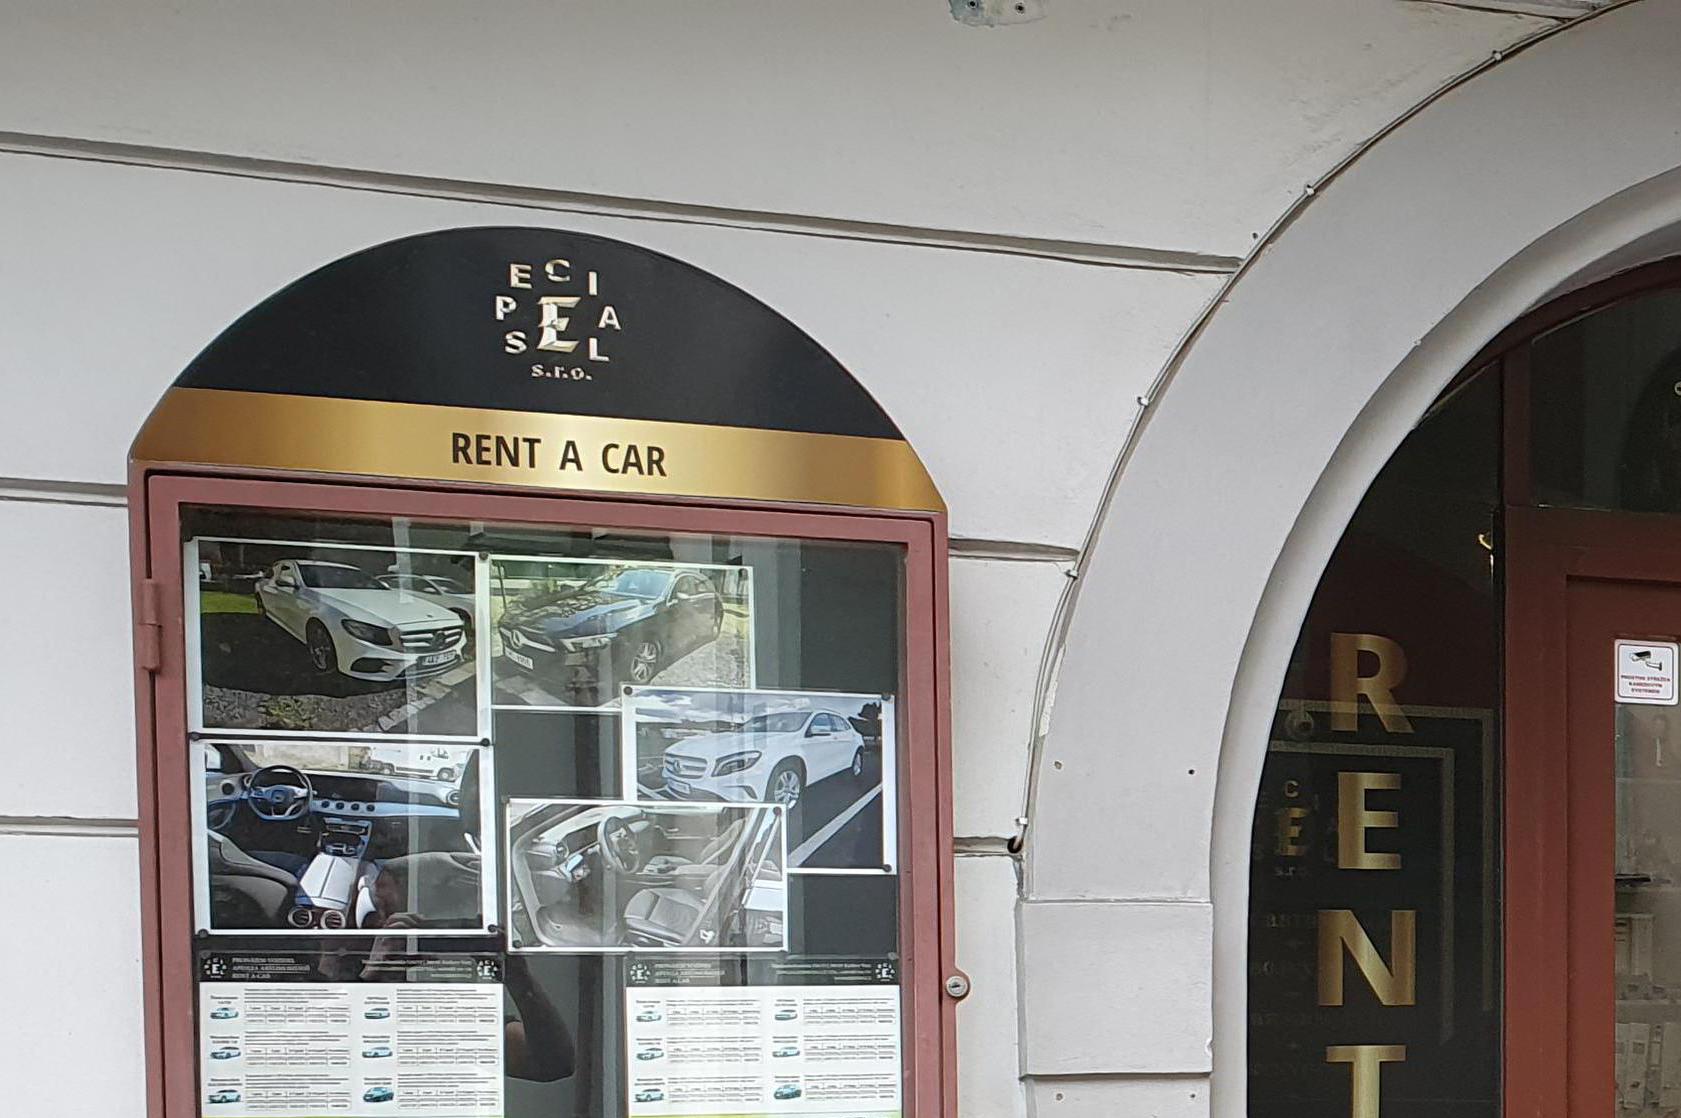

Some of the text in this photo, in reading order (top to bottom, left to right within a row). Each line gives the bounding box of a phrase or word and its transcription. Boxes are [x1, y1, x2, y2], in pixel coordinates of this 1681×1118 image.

[531, 363, 592, 382] s.r.o.
[451, 432, 667, 479] RENT A CAR
